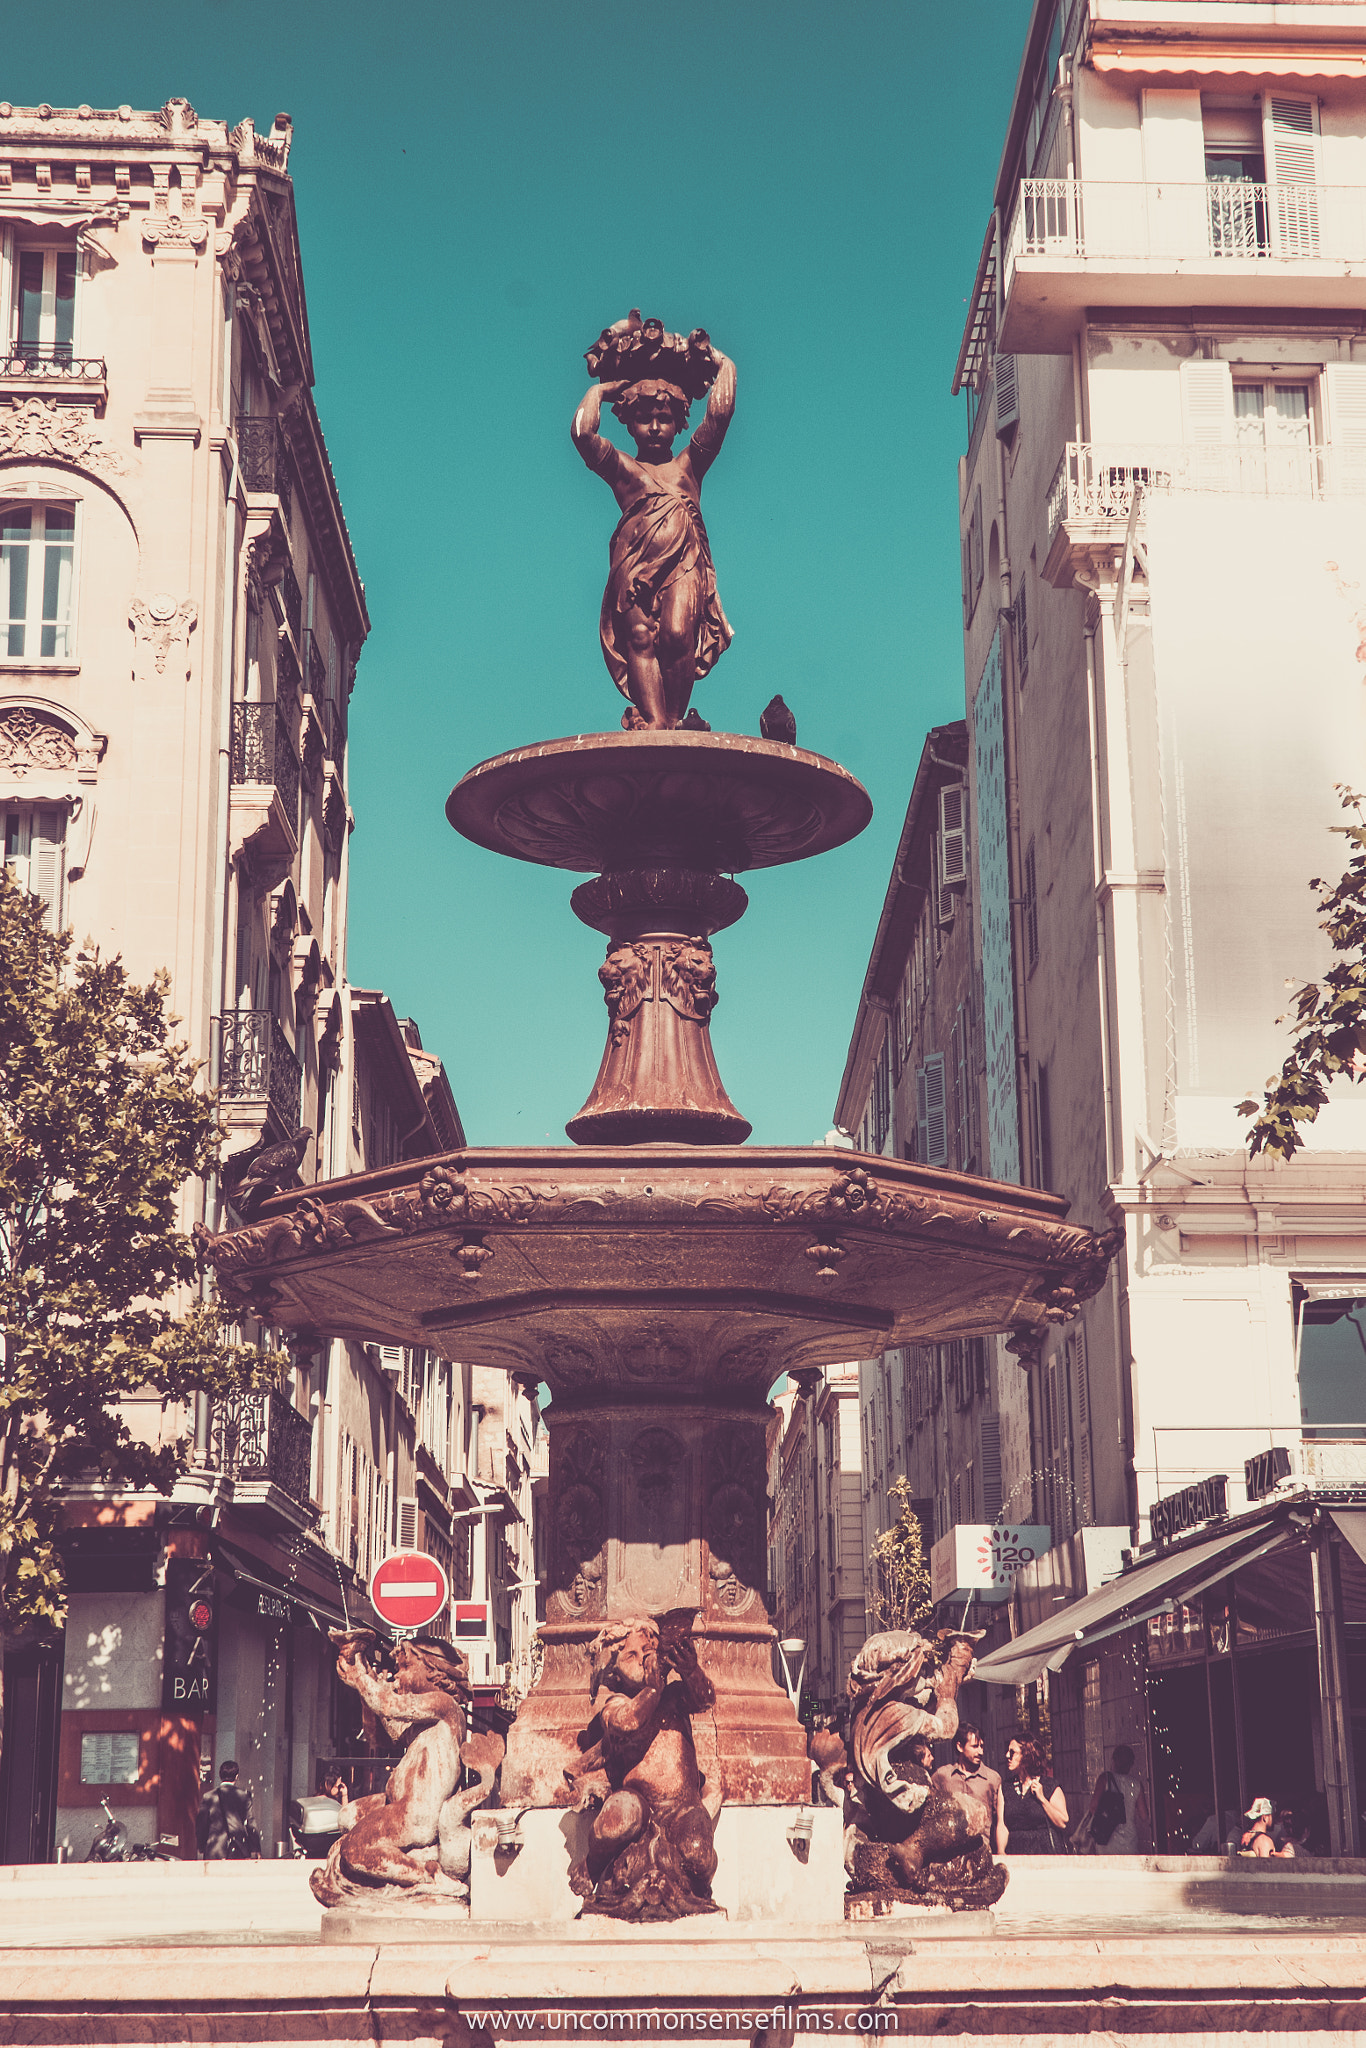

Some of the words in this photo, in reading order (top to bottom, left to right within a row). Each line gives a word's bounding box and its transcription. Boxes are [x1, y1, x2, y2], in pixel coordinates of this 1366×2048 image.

[1244, 1447, 1291, 1501] PIZZA
[1150, 1475, 1228, 1541] RESTAURANT
[992, 1547, 1035, 1562] 120
[173, 1677, 209, 1699] BAR
